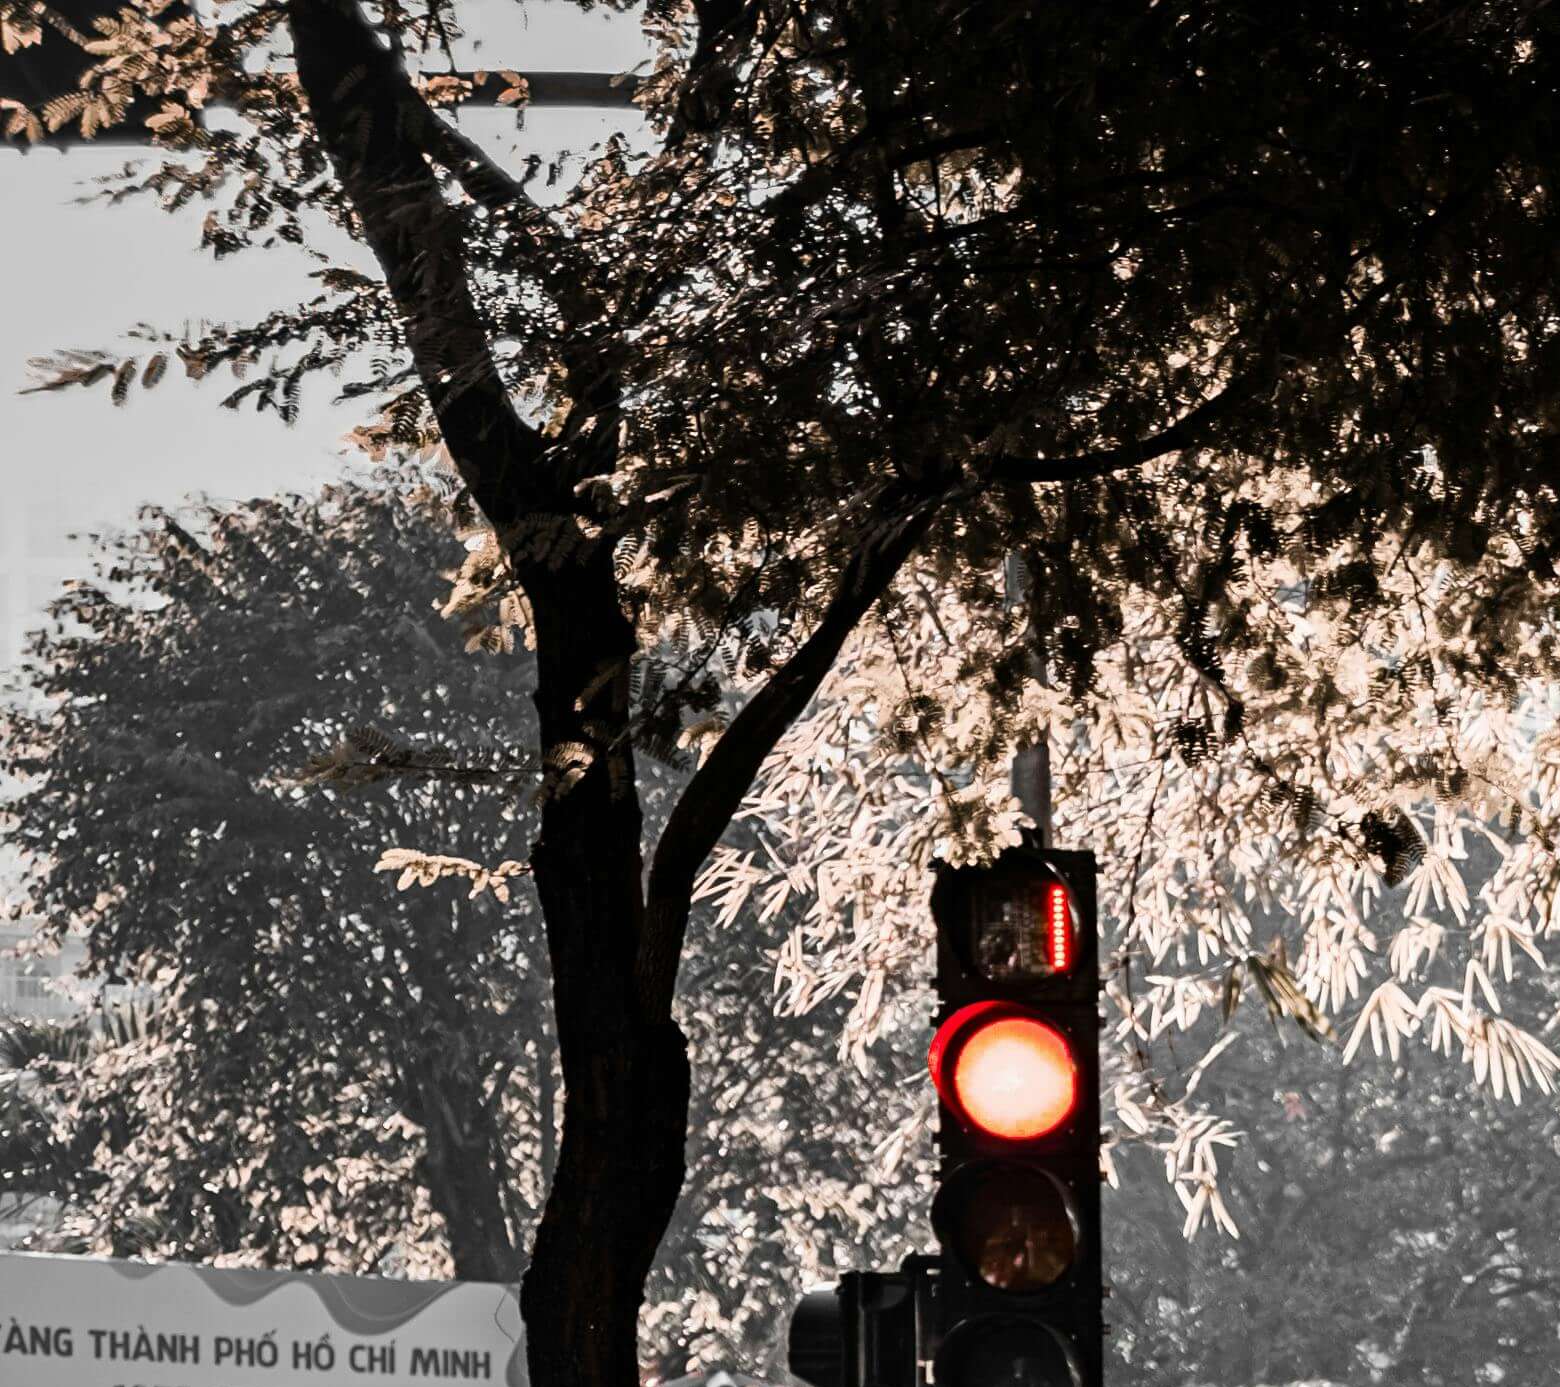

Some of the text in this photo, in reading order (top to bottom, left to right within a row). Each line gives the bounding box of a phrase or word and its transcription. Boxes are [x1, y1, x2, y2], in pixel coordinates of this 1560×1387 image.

[0, 1316, 73, 1357] ÀNG
[88, 1324, 201, 1365] THÀNH
[213, 1329, 279, 1368] PHỐ
[349, 1340, 396, 1375] CHÍ
[409, 1347, 492, 1380] MINH
